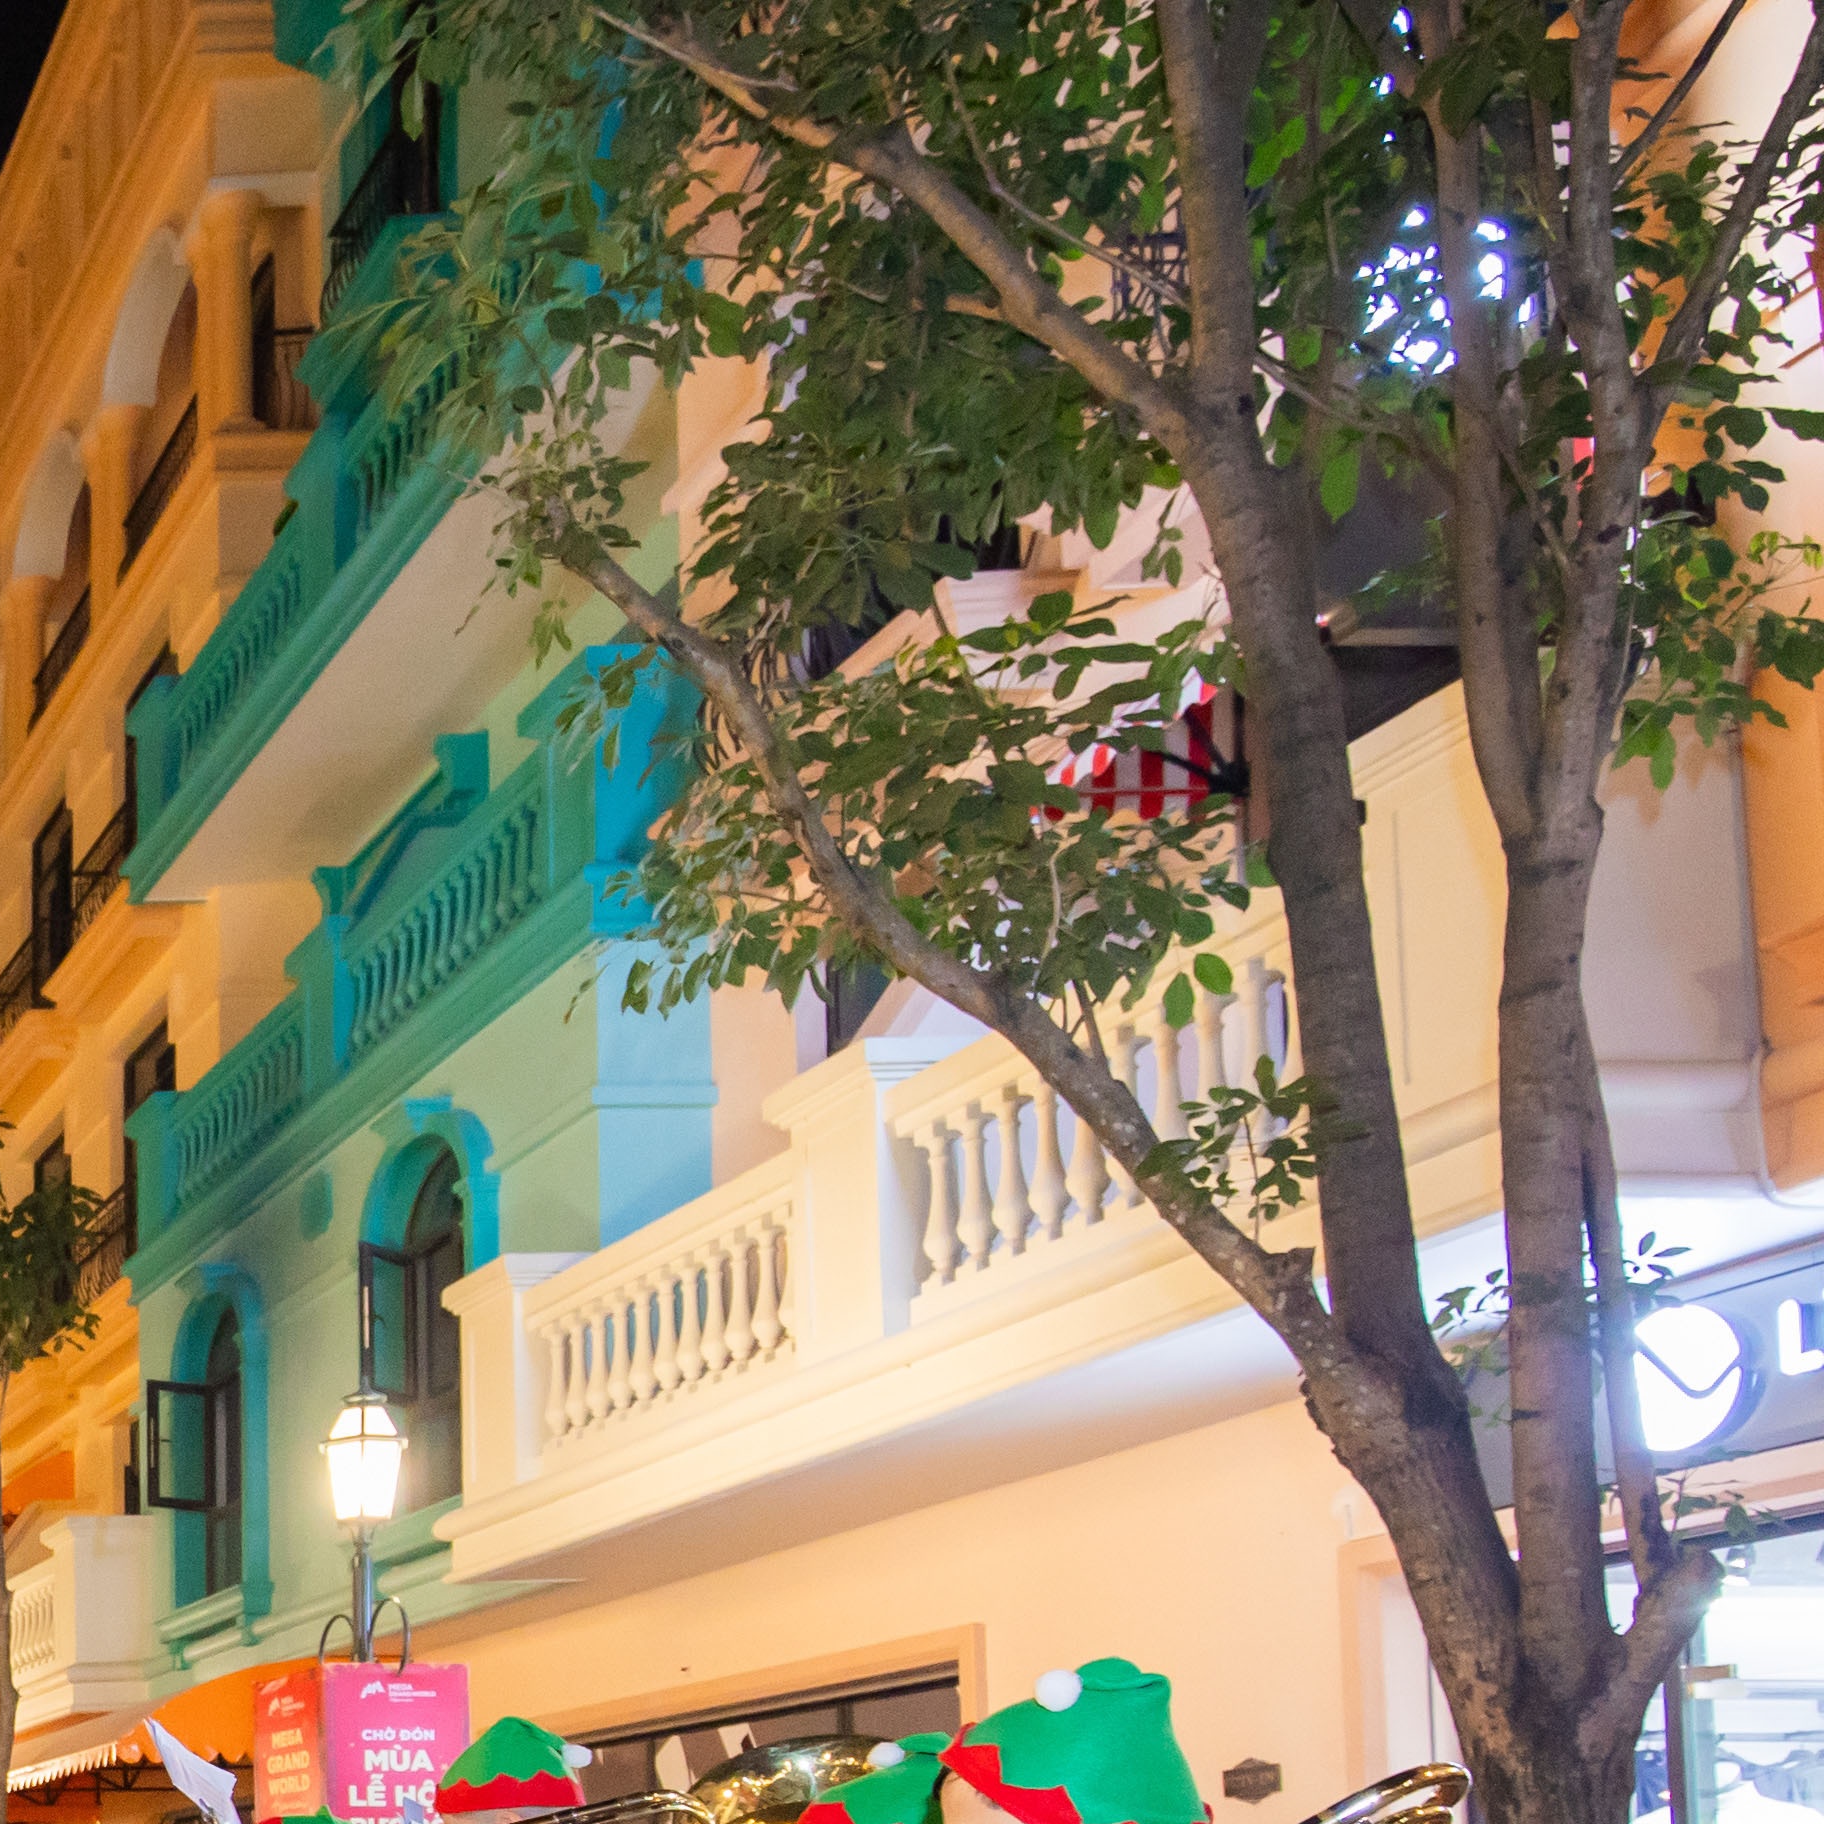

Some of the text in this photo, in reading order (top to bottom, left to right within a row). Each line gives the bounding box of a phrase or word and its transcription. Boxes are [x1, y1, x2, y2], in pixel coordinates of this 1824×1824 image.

[271, 1727, 303, 1750] MEGA
[267, 1750, 310, 1775] GRAND
[363, 1744, 435, 1772] MÙA
[268, 1773, 310, 1796] WORLD
[348, 1773, 437, 1814] LỄ HỘ
